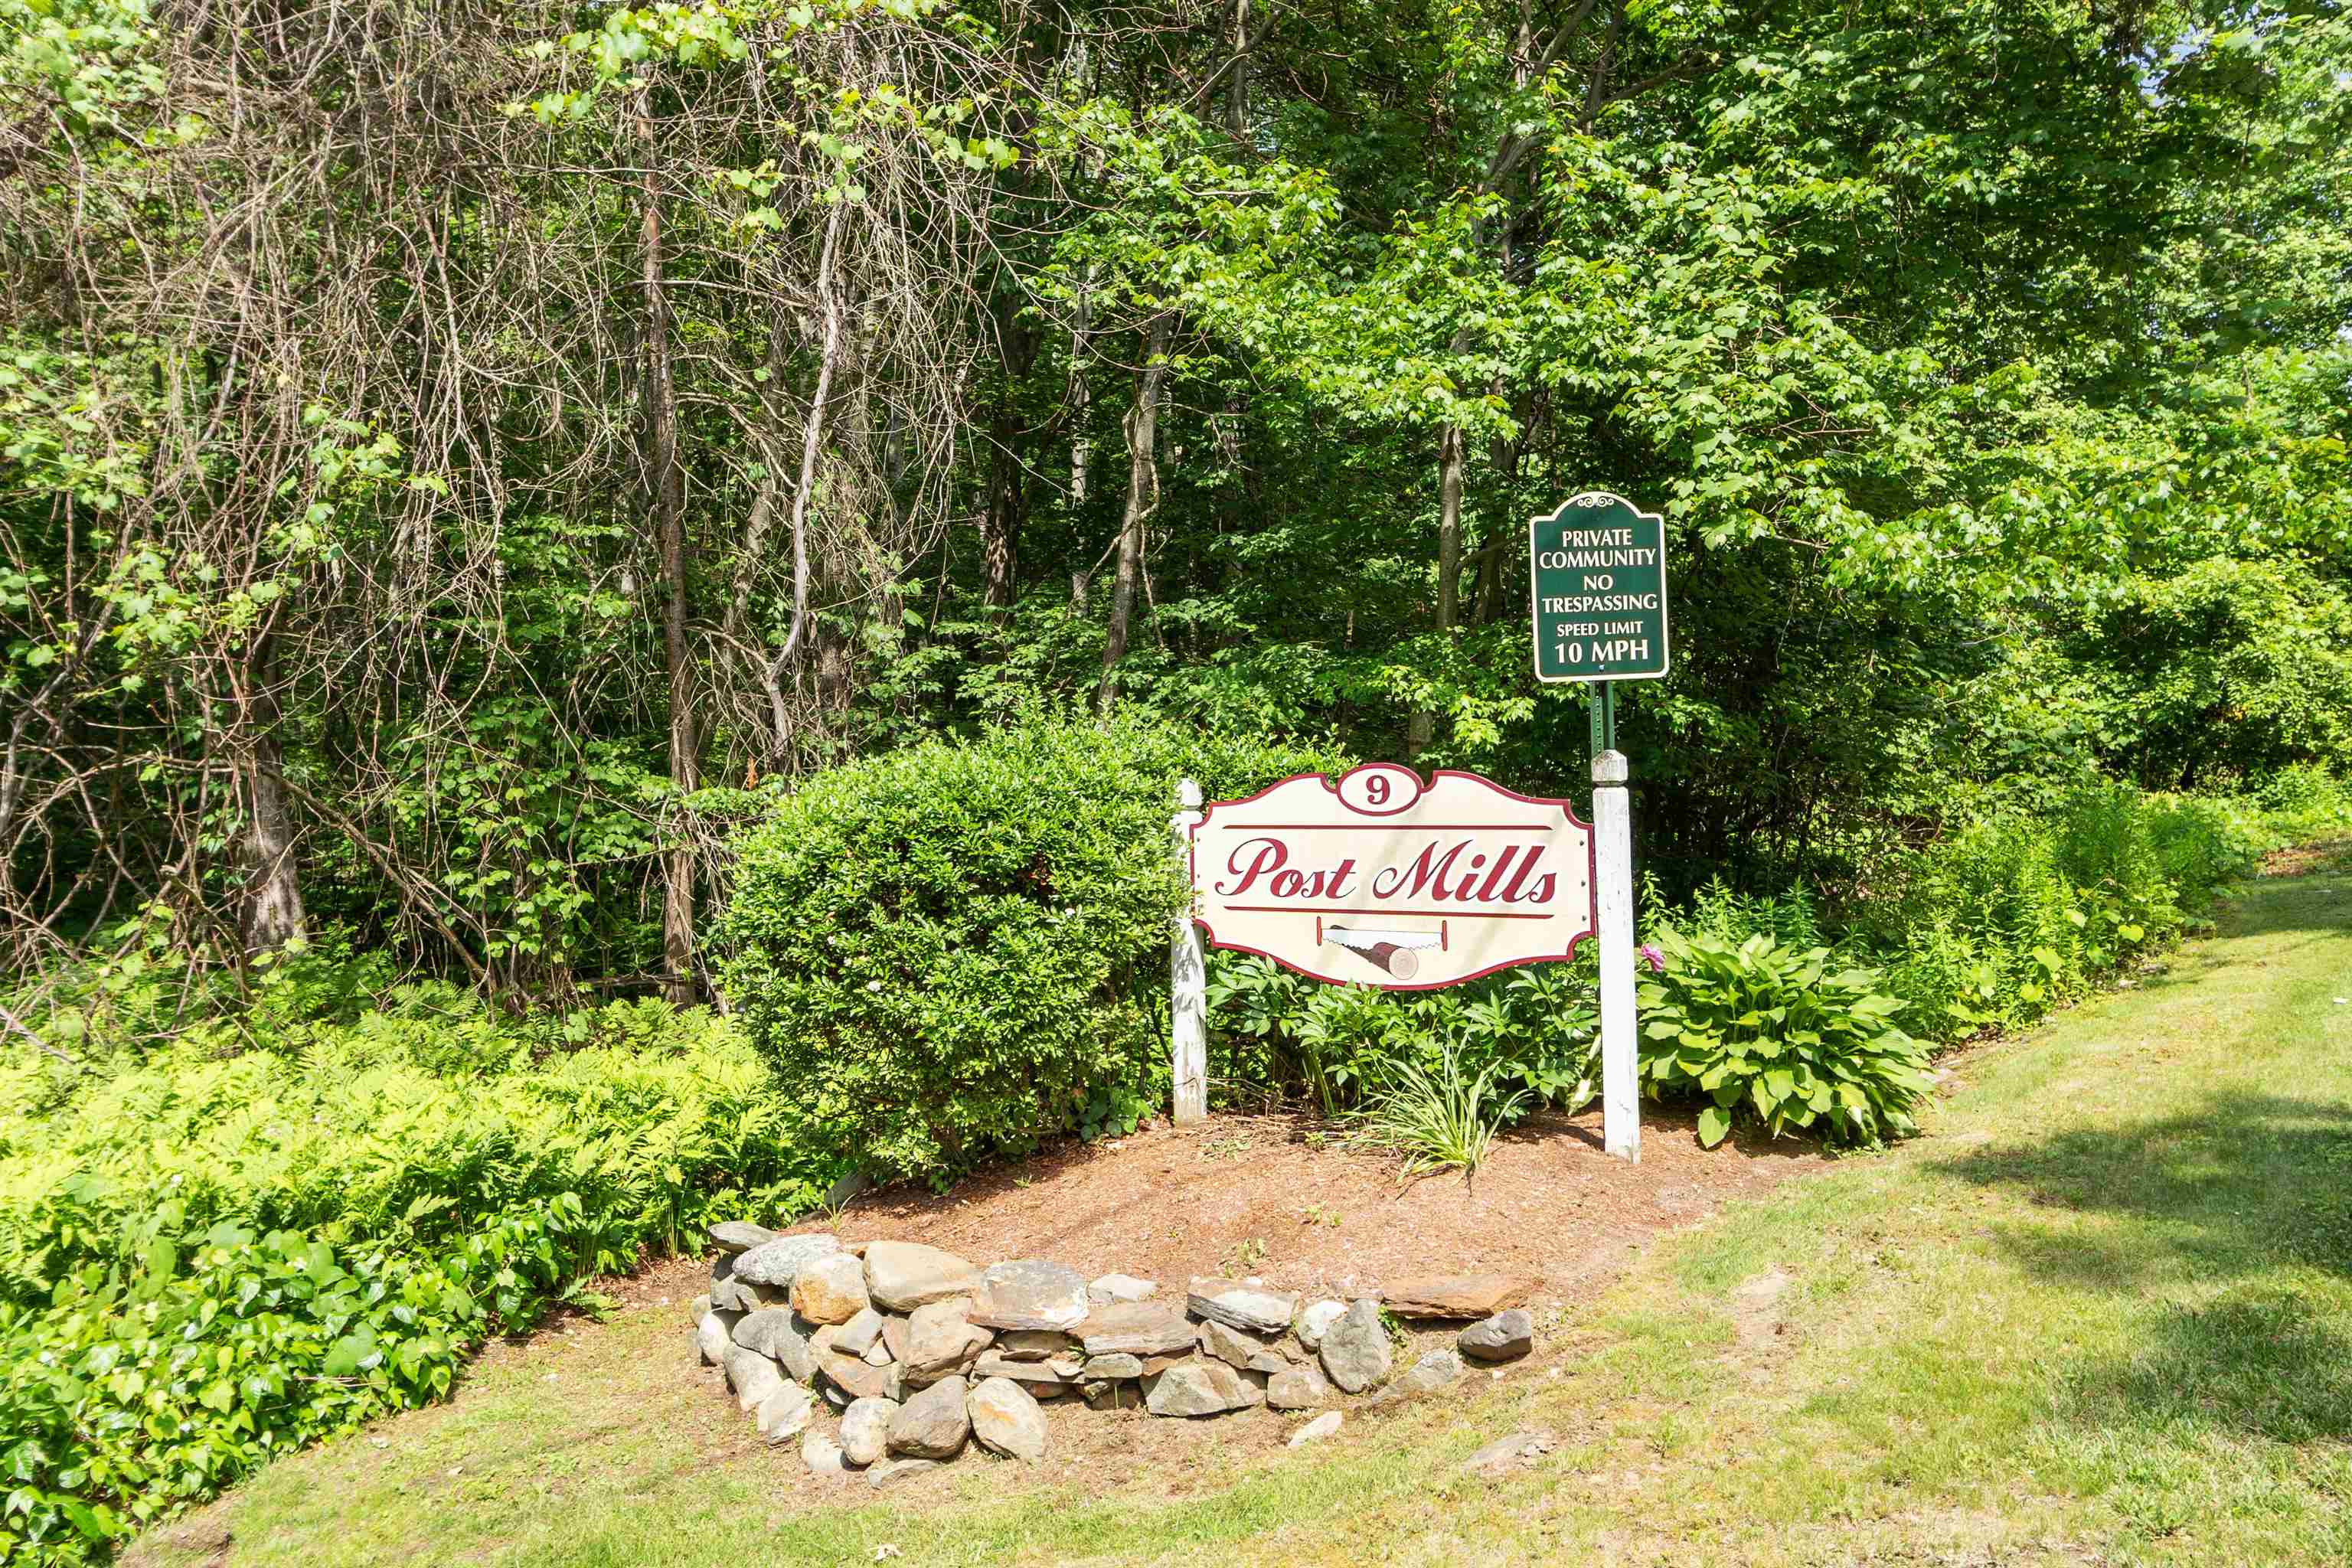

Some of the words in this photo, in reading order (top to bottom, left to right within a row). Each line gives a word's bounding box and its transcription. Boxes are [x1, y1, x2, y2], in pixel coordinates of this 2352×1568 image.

[1562, 528, 1632, 547] PRIVATE
[1539, 548, 1656, 569] COMMUNITY
[1583, 574, 1613, 590] NO
[1542, 593, 1658, 613] TRESPASSING
[1557, 622, 1599, 637] SPEED
[1604, 621, 1644, 635] LIMIT
[1555, 642, 1583, 664] 10
[1591, 639, 1648, 663] MPH
[1365, 774, 1391, 805] 9
[1214, 837, 1357, 899] Post
[1373, 838, 1557, 903] Mills
